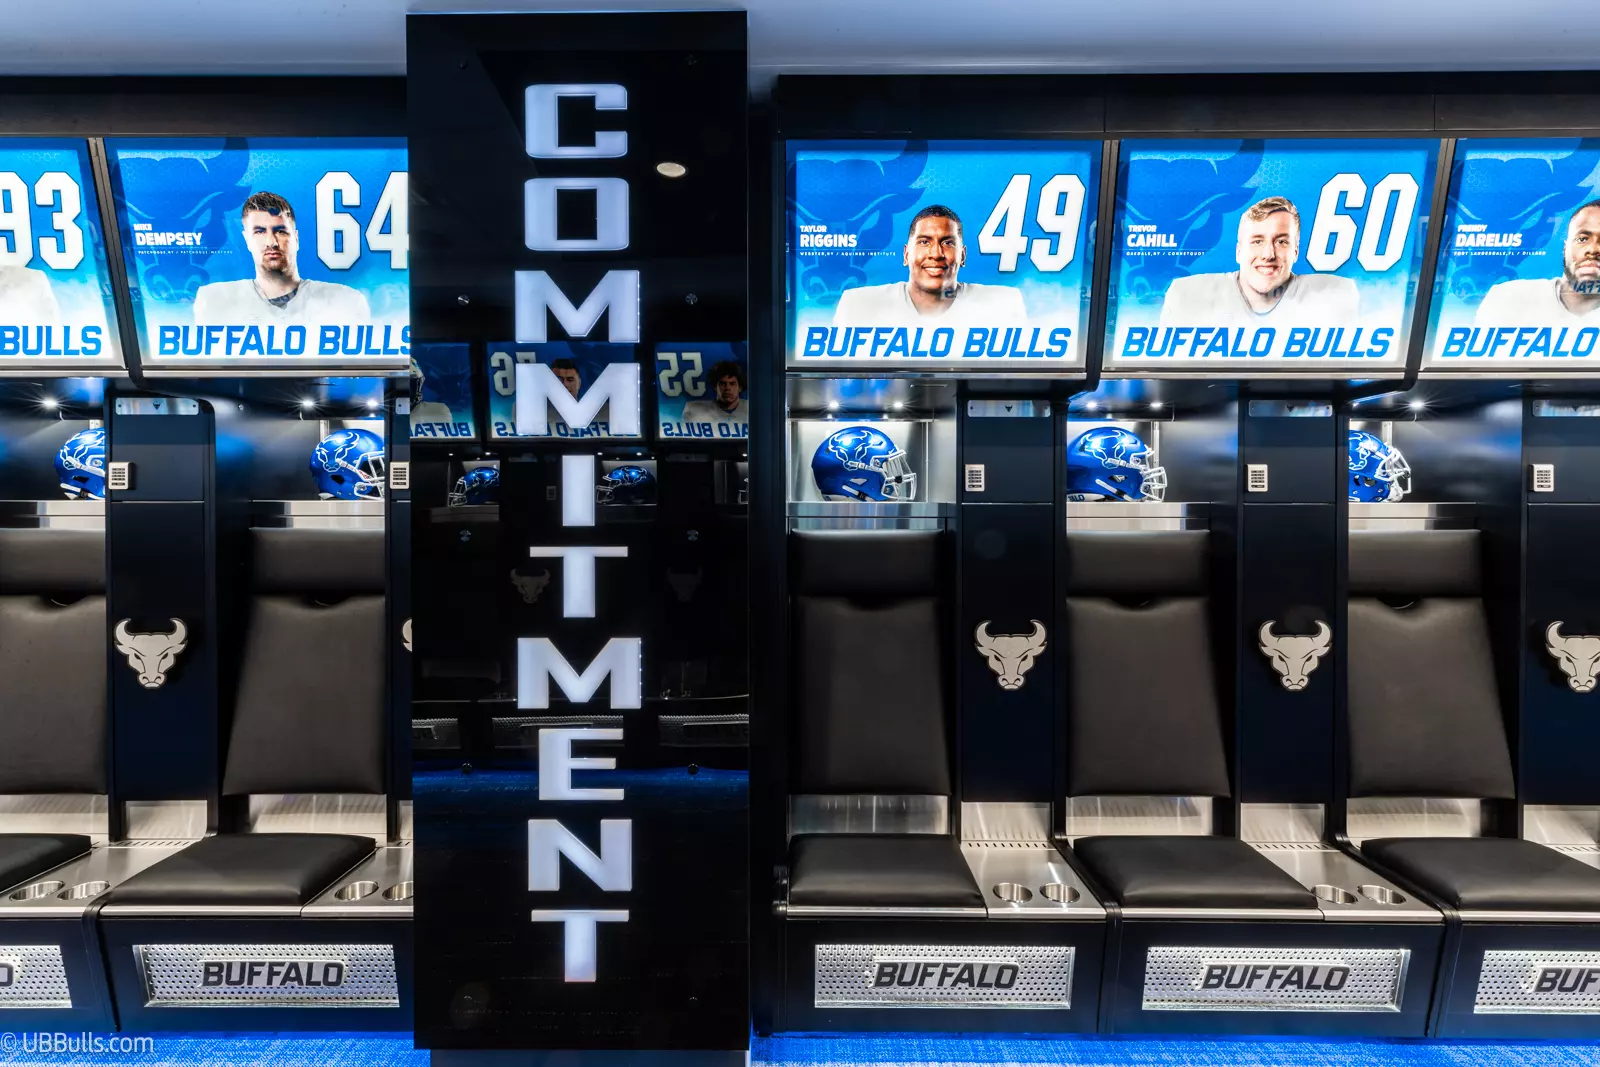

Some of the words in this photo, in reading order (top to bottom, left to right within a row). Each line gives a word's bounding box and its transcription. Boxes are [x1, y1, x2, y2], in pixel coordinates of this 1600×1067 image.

[0, 171, 84, 270] 93
[315, 171, 409, 270] 64
[977, 173, 1087, 272] 49
[1306, 172, 1419, 272] 60
[135, 232, 202, 246] DEMPSEY
[800, 234, 857, 247] RIGGINS
[1127, 234, 1177, 247] CAHILL
[1455, 233, 1522, 247] DARELUS
[0, 326, 102, 356] BULLS
[158, 325, 307, 356] BUFFALO
[803, 326, 954, 357] BUFFALO
[962, 327, 1072, 357] BULLS
[1121, 327, 1276, 357] BUFFALO
[1282, 327, 1394, 357] BULLS
[1441, 327, 1600, 357] BUFFALO
[514, 84, 641, 982] COMMITMENT
[202, 961, 344, 987] BUFFALO
[873, 962, 1020, 989] BUFFALO
[1200, 964, 1350, 990] BUFFALO
